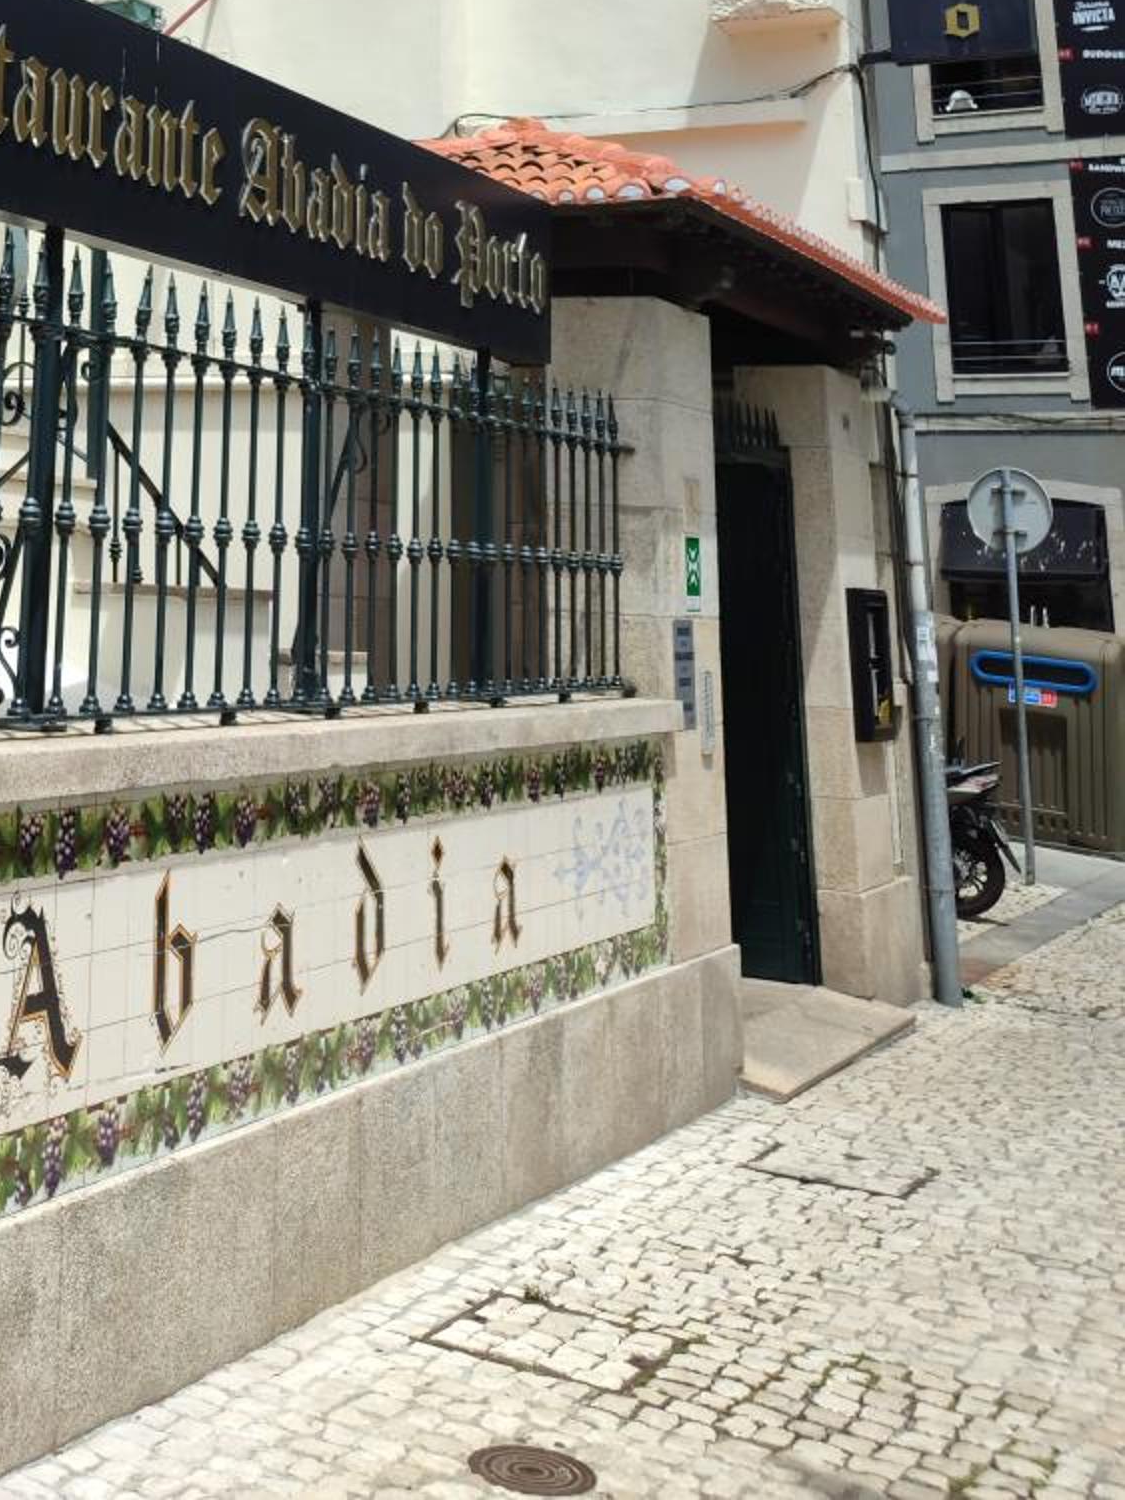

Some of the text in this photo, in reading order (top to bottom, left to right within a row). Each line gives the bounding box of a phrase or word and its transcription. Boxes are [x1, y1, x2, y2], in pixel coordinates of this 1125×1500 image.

[239, 116, 390, 263] Abadia
[402, 180, 445, 278] do
[451, 199, 549, 315] Porto
